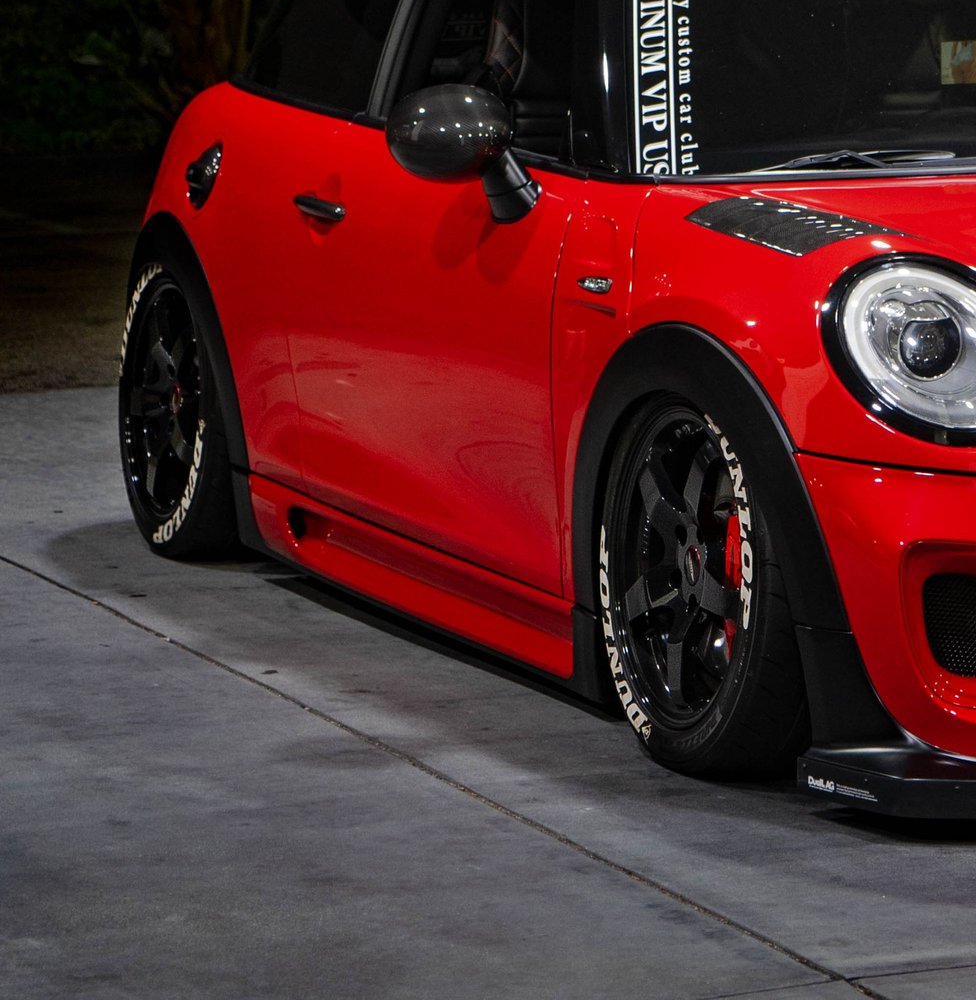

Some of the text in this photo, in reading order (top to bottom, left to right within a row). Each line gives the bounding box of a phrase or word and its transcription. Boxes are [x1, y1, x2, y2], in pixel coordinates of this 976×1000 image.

[678, 16, 692, 85] custom
[641, 79, 667, 132] VIP
[679, 93, 692, 124] car
[152, 429, 204, 543] DUNLOP
[599, 524, 650, 734] DUNLOP
